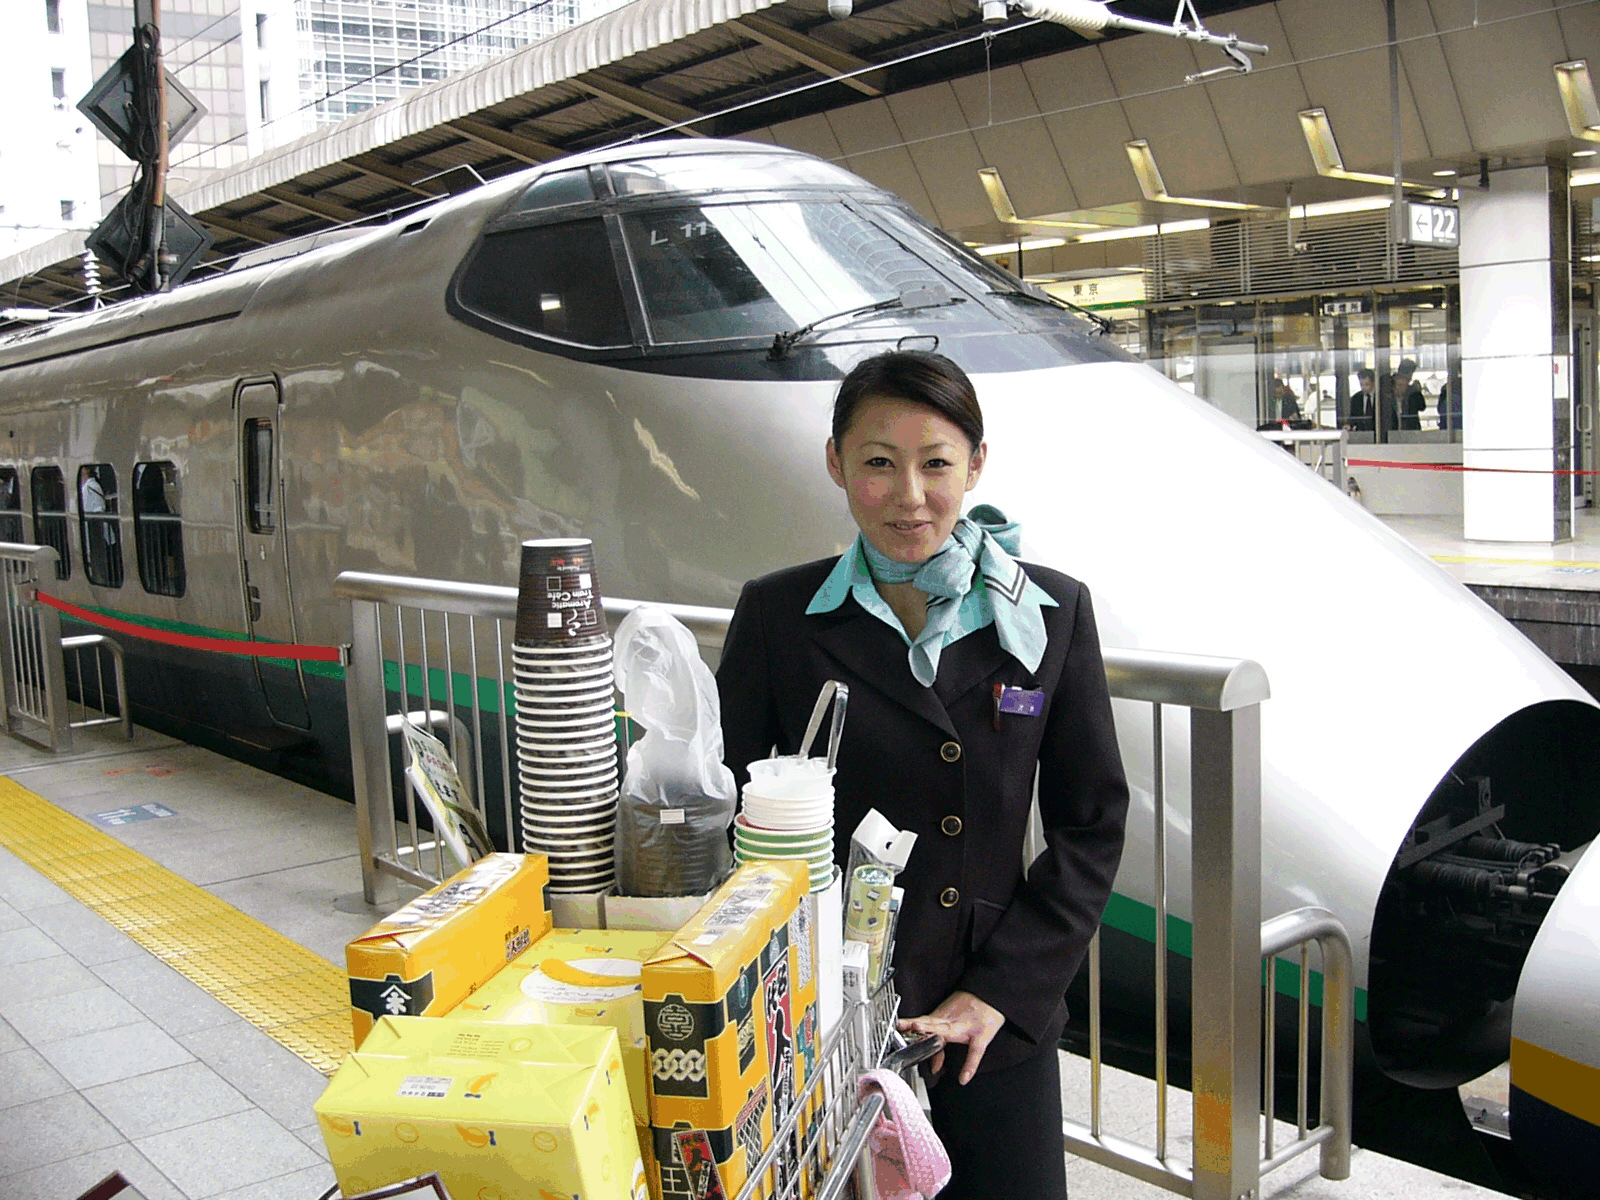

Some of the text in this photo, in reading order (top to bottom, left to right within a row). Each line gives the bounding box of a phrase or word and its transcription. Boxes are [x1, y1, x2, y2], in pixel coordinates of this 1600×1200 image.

[1432, 208, 1456, 239] 22
[1073, 283, 1098, 297] 東京
[572, 589, 594, 599] Train
[552, 600, 591, 610] Aromatic
